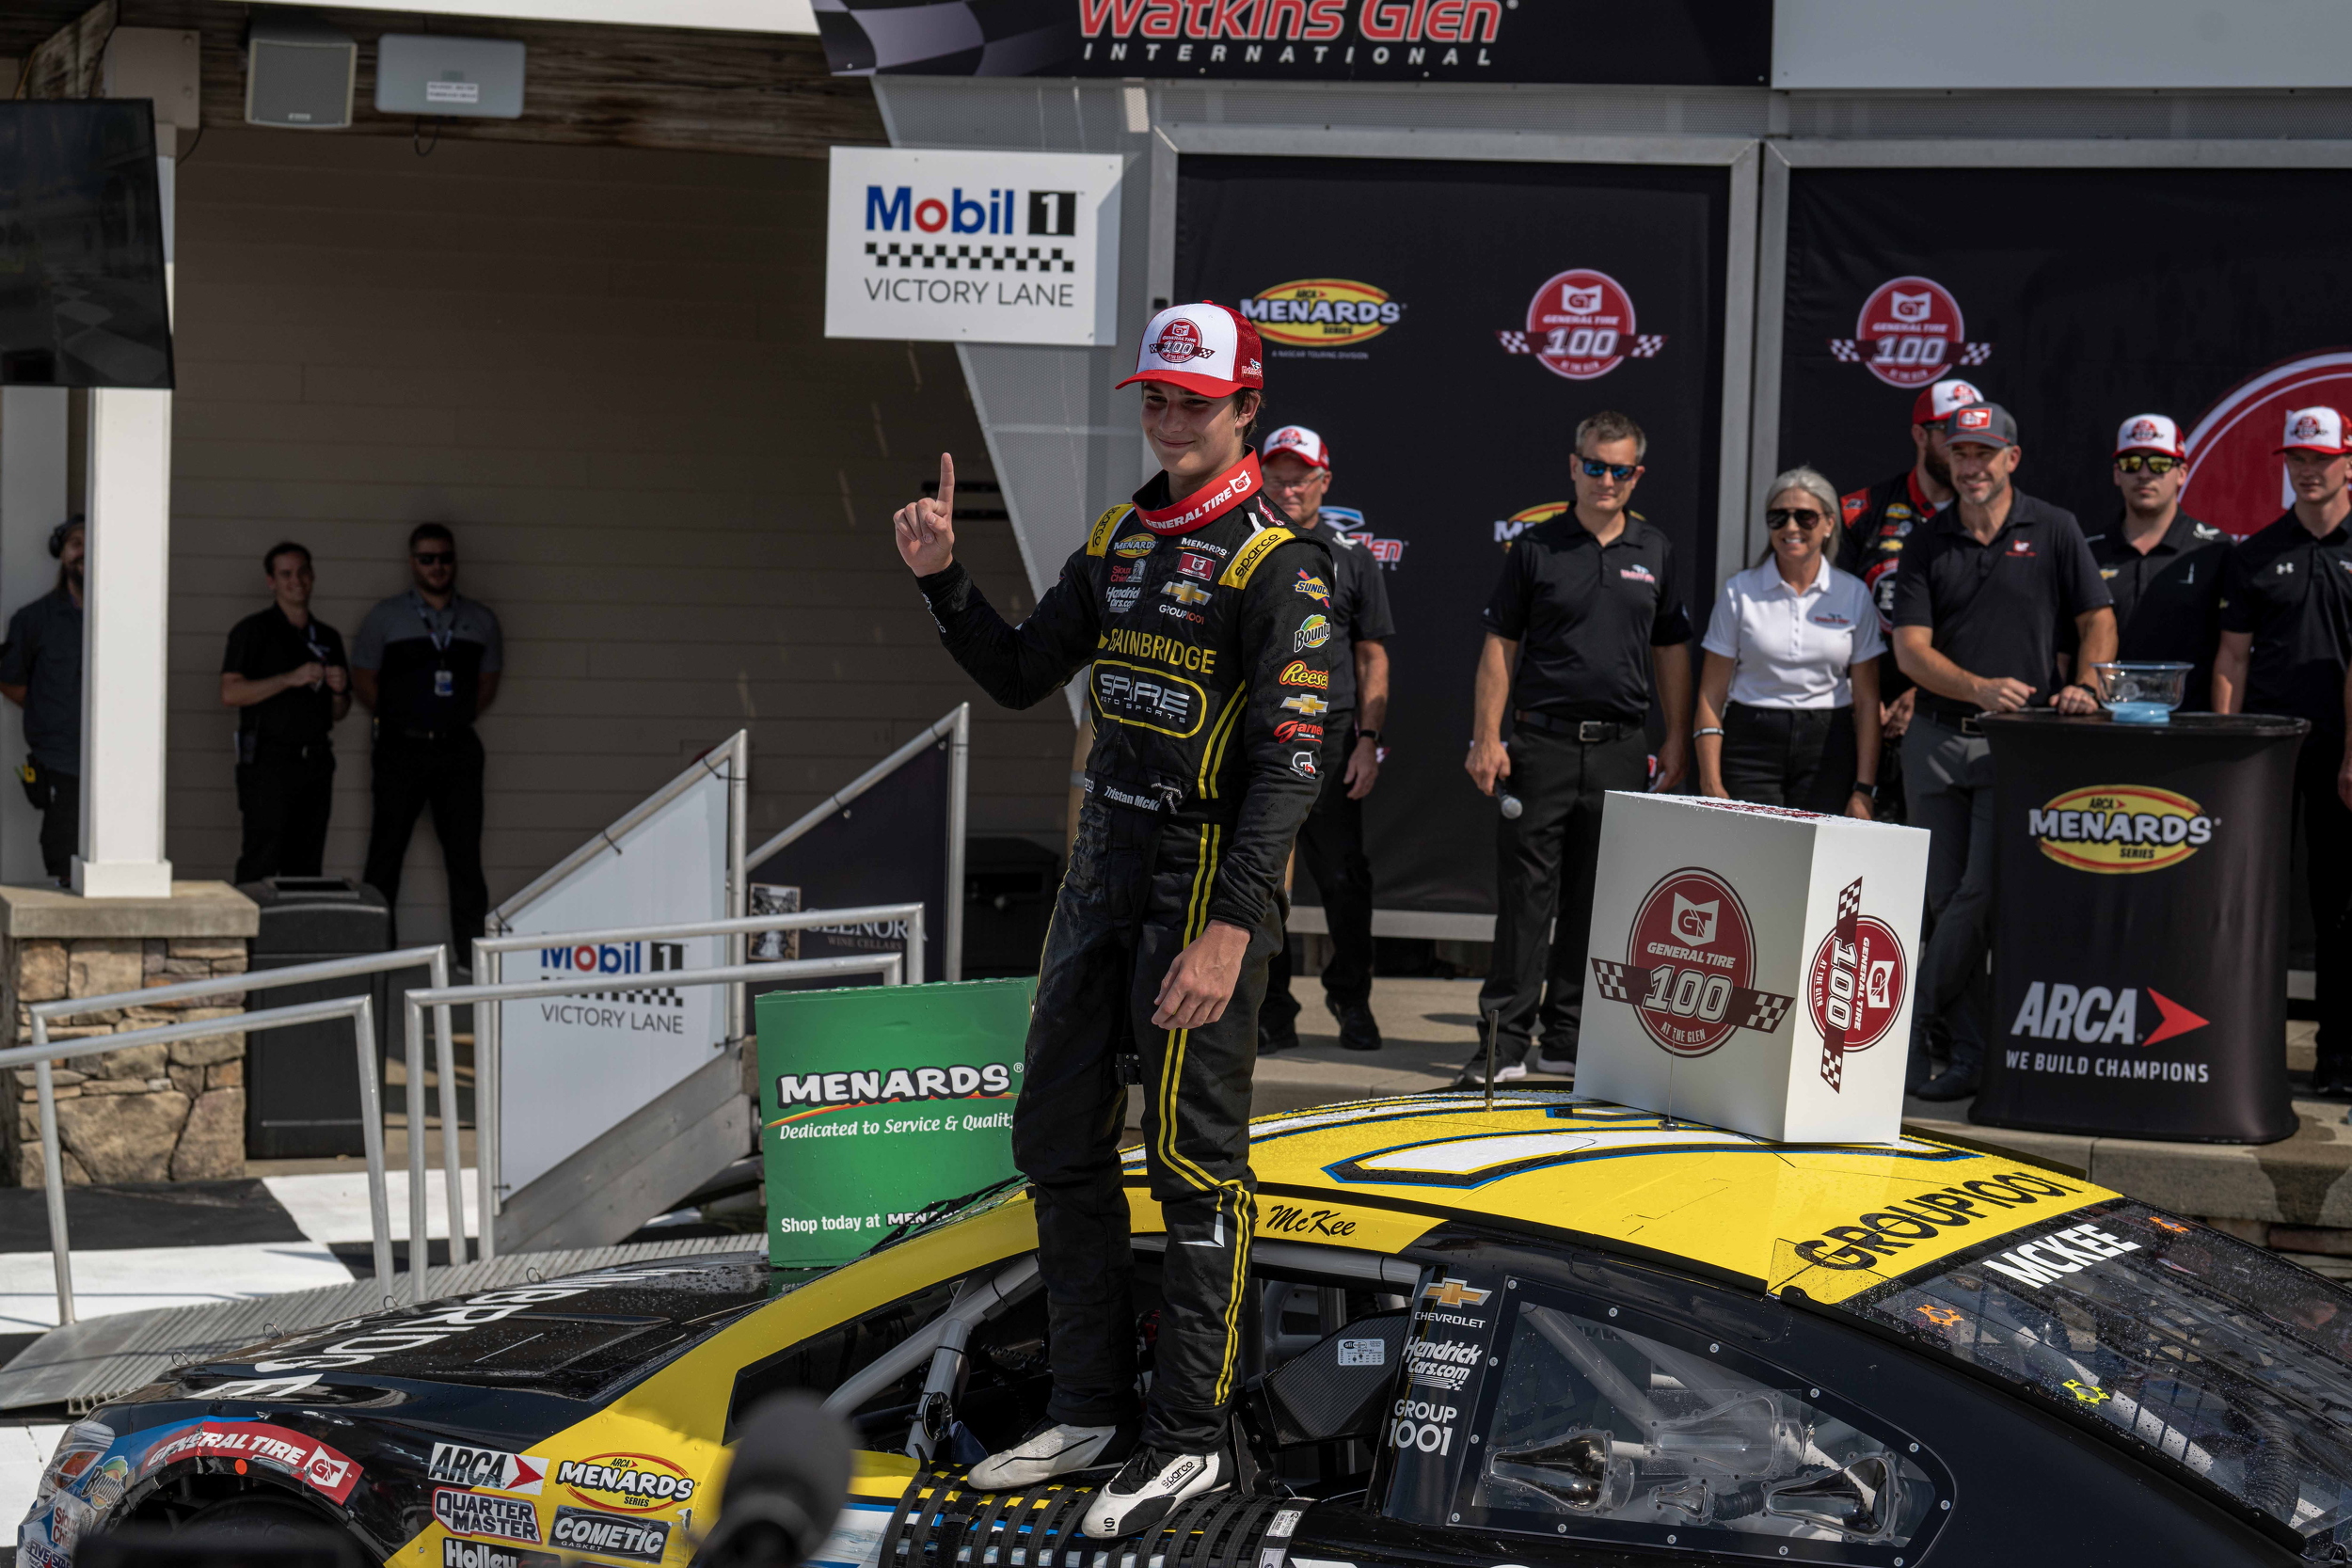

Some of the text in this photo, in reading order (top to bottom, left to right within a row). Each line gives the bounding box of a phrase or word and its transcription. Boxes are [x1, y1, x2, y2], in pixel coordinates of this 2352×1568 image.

[1079, 0, 1502, 41] Watkins Glen
[1083, 42, 1492, 66] INTERNATIONAL
[866, 184, 1014, 234] Mobil
[865, 277, 1074, 308] VICTORY LANE
[1239, 298, 1401, 325] MENARDS
[1543, 314, 1620, 325] GENERAL TIRE
[1161, 341, 1195, 355] 100
[1542, 327, 1620, 357] 100
[1871, 335, 1948, 366] 100
[1145, 511, 1203, 530] GENERAL
[1202, 486, 1232, 514] TIRE
[1114, 540, 1156, 550] MENARDS
[1181, 536, 1228, 557] MENARDS
[1234, 533, 1281, 579] sparco
[1110, 574, 1128, 582] Chief
[1112, 565, 1132, 574] Sioux
[1108, 627, 1217, 674] GAINBRIDGE
[1294, 622, 1330, 653] Bounty
[1104, 785, 1134, 804] Tristan
[2090, 798, 2114, 809] ARCA
[2028, 808, 2213, 846] MENARDS
[2120, 847, 2154, 860] SERIES
[541, 942, 641, 974] Mobil
[857, 938, 903, 951] CELLARS
[1646, 942, 1737, 969] GENERAL TIRE
[1641, 963, 1734, 1024] 100
[1815, 958, 1828, 1007] AT THE GLEN
[1825, 936, 1858, 1031] 100
[1853, 936, 1870, 1031] GENERAL TIRE
[541, 1003, 683, 1034] VICTORY LANE
[2010, 981, 2138, 1045] ARCA
[1661, 1022, 1671, 1036] AT
[1687, 1028, 1707, 1043] GLEN
[2006, 1050, 2209, 1083] WE BUILD CHAMPIONS
[778, 1063, 1011, 1108] MENARDS
[780, 1122, 858, 1139] Dedicated
[862, 1122, 880, 1134] to
[883, 1116, 940, 1133] Service
[945, 1116, 959, 1131] &
[781, 1217, 818, 1236] Shop
[822, 1216, 861, 1233] today
[865, 1214, 881, 1227] at
[1269, 1204, 1357, 1237] McKee
[1794, 1171, 2085, 1270] GROUP1001
[1982, 1224, 2141, 1289] MCKEE
[1414, 1311, 1486, 1329] CHEVROLET
[1402, 1336, 1483, 1366] Hendrick
[1408, 1358, 1470, 1381] Cars.com
[1394, 1399, 1457, 1424] GROUP
[148, 1430, 308, 1467] GENERAL TIRE
[1389, 1418, 1453, 1456] 1001
[429, 1446, 509, 1483] ARCA
[611, 1458, 630, 1467] ARCA
[1161, 1461, 1195, 1489] sparco
[81, 1465, 126, 1510] Bounty
[556, 1461, 694, 1502] MENARDS
[436, 1489, 533, 1521] QUARTER
[624, 1497, 649, 1507] SERIES
[453, 1513, 537, 1540] MASTER
[554, 1517, 664, 1554] COMETIC
[30, 1543, 51, 1562] FIVE
[561, 1541, 602, 1551] GASKET
